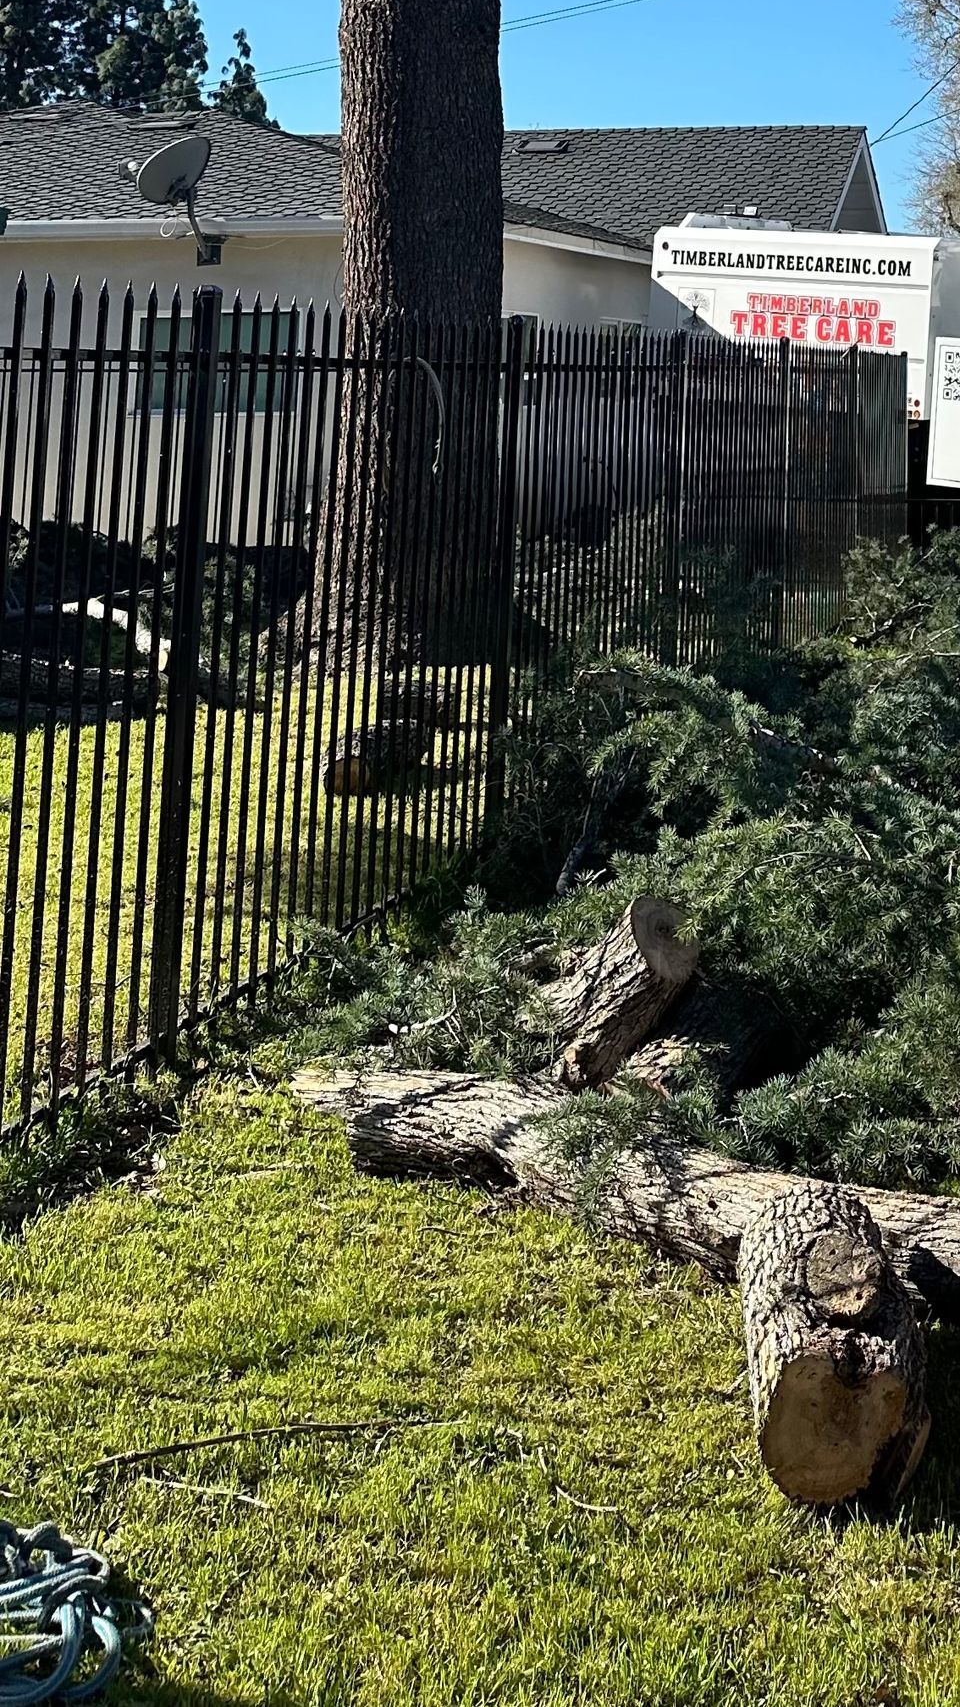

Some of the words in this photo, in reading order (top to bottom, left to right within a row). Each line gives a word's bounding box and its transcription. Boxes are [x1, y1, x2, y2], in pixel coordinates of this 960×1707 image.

[671, 249, 912, 277] TIMBERLANDTREECAREINC.COM
[748, 293, 880, 319] TIMBERLAND
[731, 301, 808, 340] TREE
[815, 316, 896, 347] CARE
